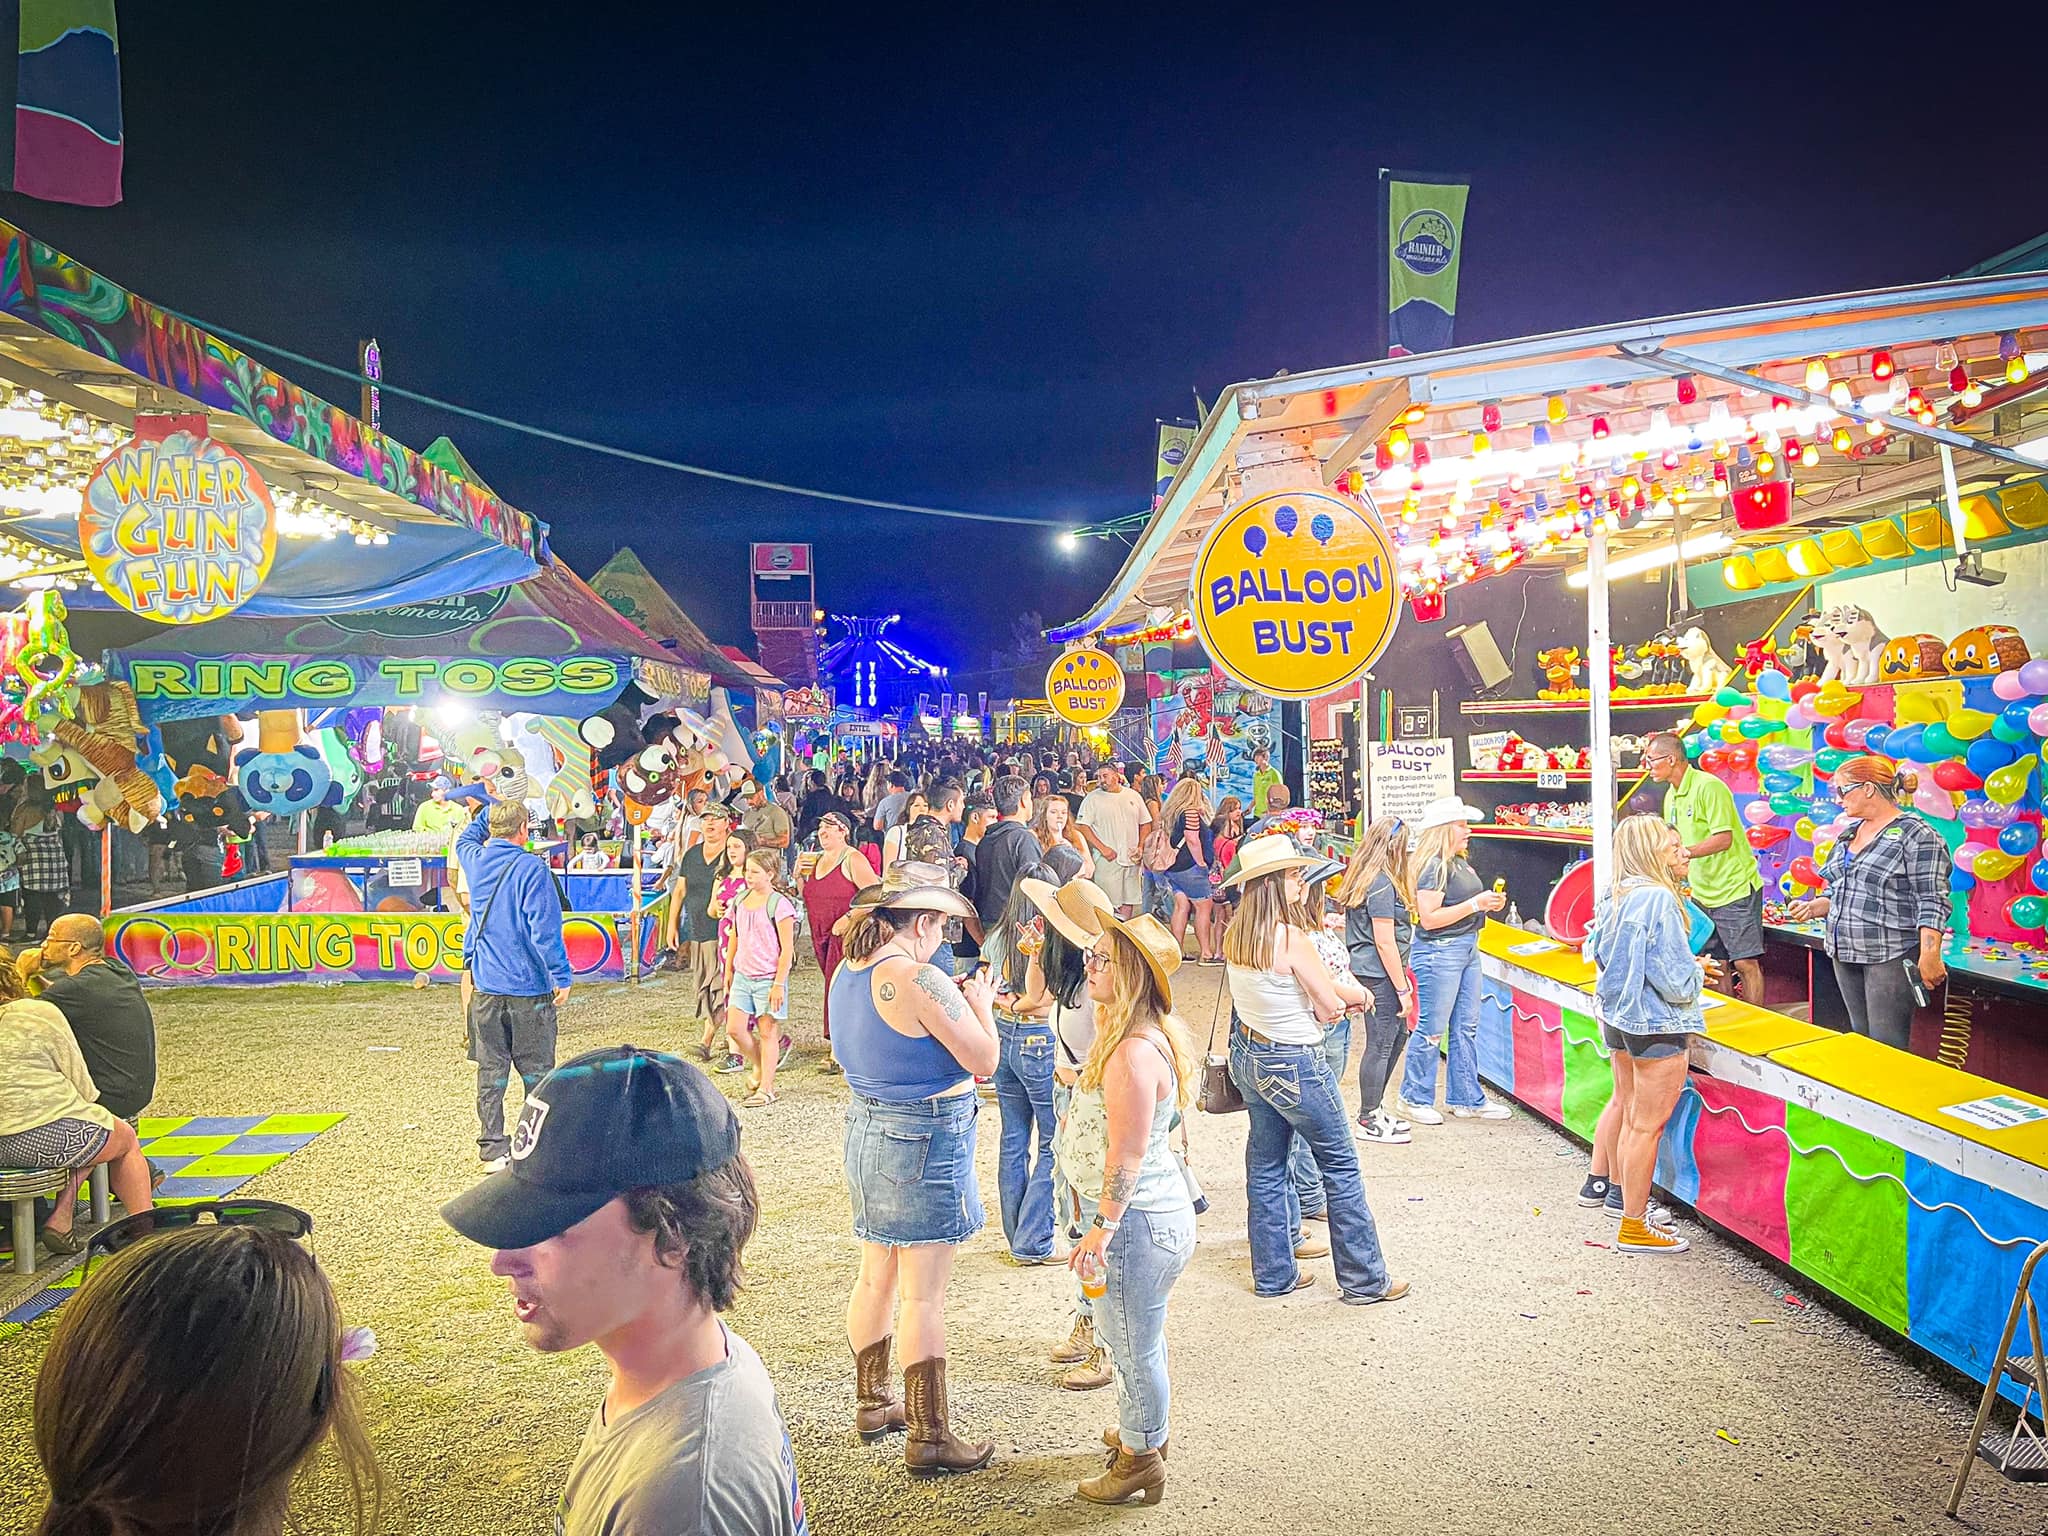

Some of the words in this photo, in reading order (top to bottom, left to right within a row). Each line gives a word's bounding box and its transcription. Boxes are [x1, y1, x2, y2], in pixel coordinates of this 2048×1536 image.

[1408, 242, 1443, 256] RAINIER
[103, 451, 249, 505] WATER
[116, 502, 239, 557] GUN
[125, 558, 241, 608] FUN
[1211, 555, 1383, 617] BALLOON
[1253, 619, 1353, 655] BUST
[133, 660, 351, 696] RING
[381, 659, 617, 695] TOSS
[1053, 674, 1117, 695] BALLOON
[1069, 696, 1106, 711] BUST
[1377, 744, 1445, 757] BALLOON
[1392, 759, 1432, 772] BUST
[1541, 774, 1546, 786] 8
[1548, 774, 1563, 785] POP
[216, 923, 352, 971] RING
[370, 922, 465, 971] TOS
